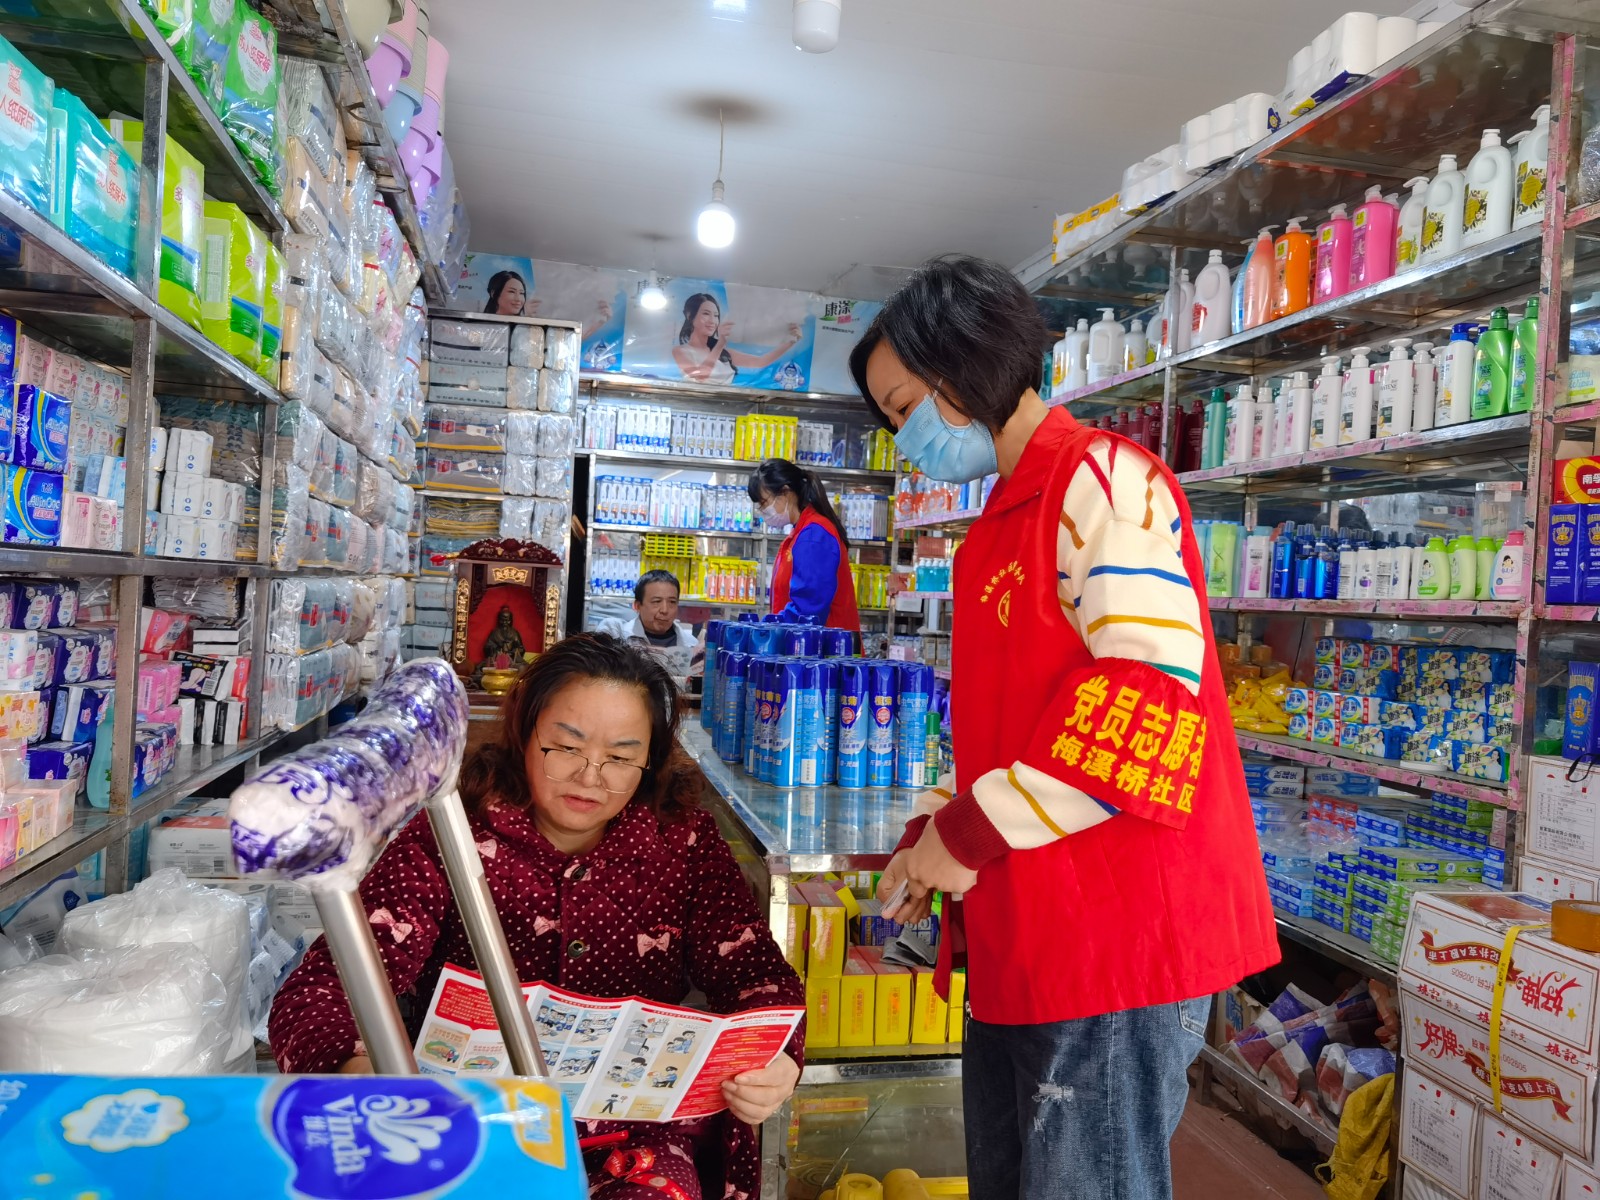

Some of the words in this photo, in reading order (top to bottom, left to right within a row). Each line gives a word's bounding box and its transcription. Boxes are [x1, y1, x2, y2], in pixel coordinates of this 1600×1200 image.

[1051, 731, 1196, 814] 梅溪桥社区
[1427, 946, 1500, 962] 记扑克A股上市
[322, 1094, 372, 1177] Vinda
